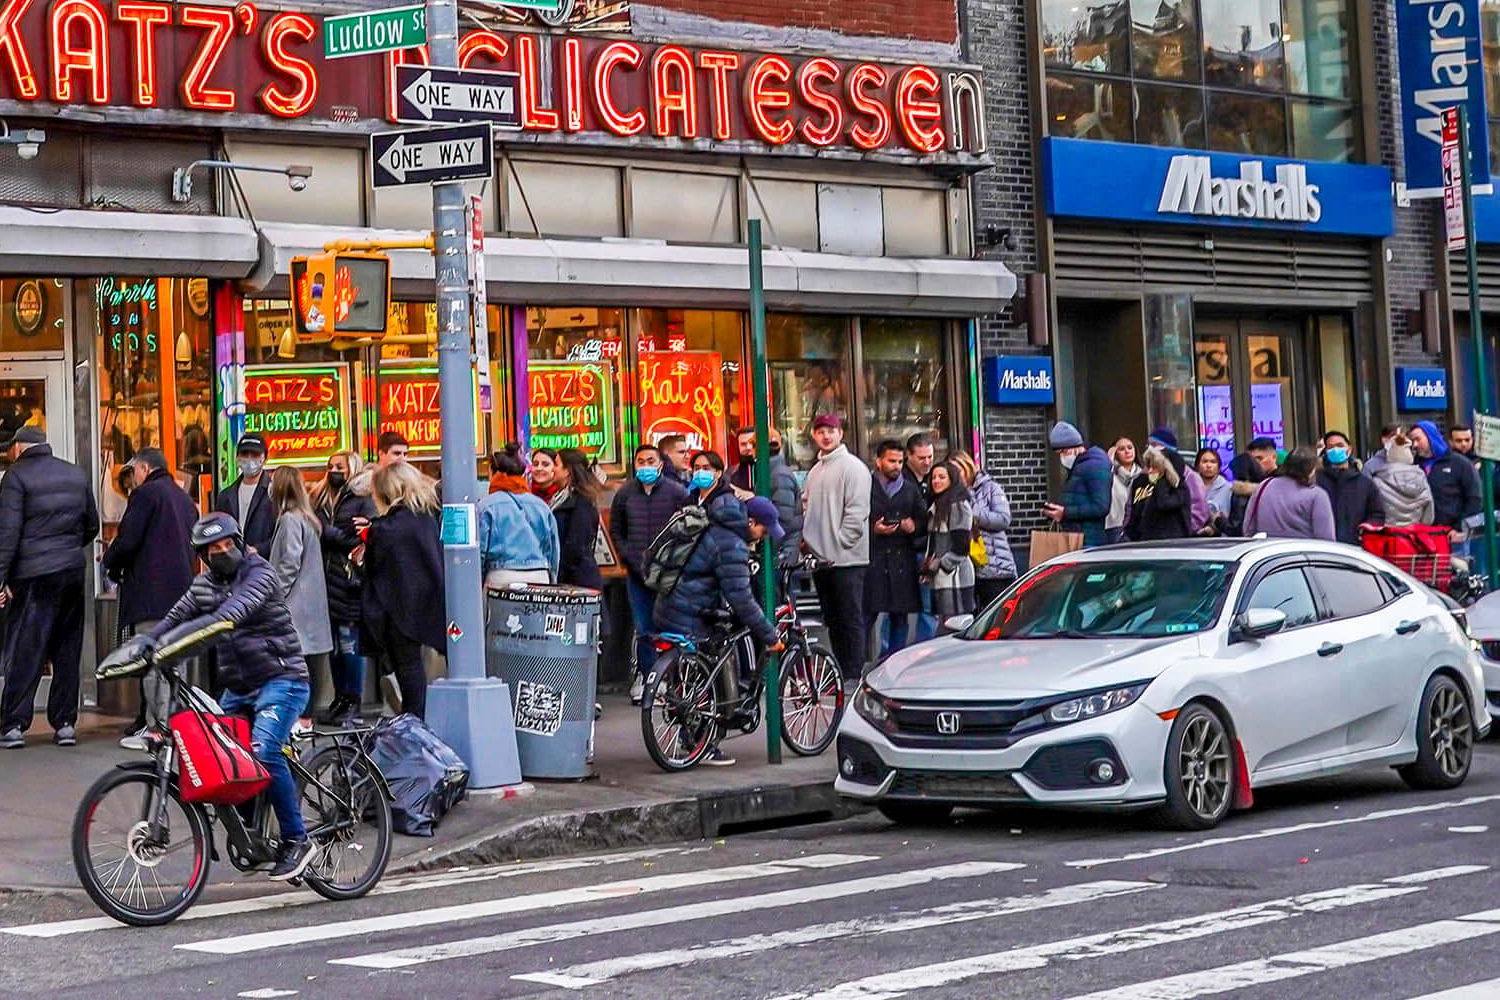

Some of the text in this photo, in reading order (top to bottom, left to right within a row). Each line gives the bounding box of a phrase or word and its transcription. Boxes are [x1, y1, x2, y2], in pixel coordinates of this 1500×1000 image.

[328, 10, 426, 54] Ludlow St
[416, 84, 505, 110] ONE WAY
[390, 142, 475, 169] ONE WAY
[1157, 154, 1321, 223] Marshalls
[531, 370, 596, 404] ATZ'S
[1000, 368, 1052, 391] Marshalls
[1405, 379, 1446, 399] Marshalls
[388, 382, 440, 416] KATZ
[245, 406, 339, 433] ELICATESSEN
[529, 405, 598, 428] LICATESSEN
